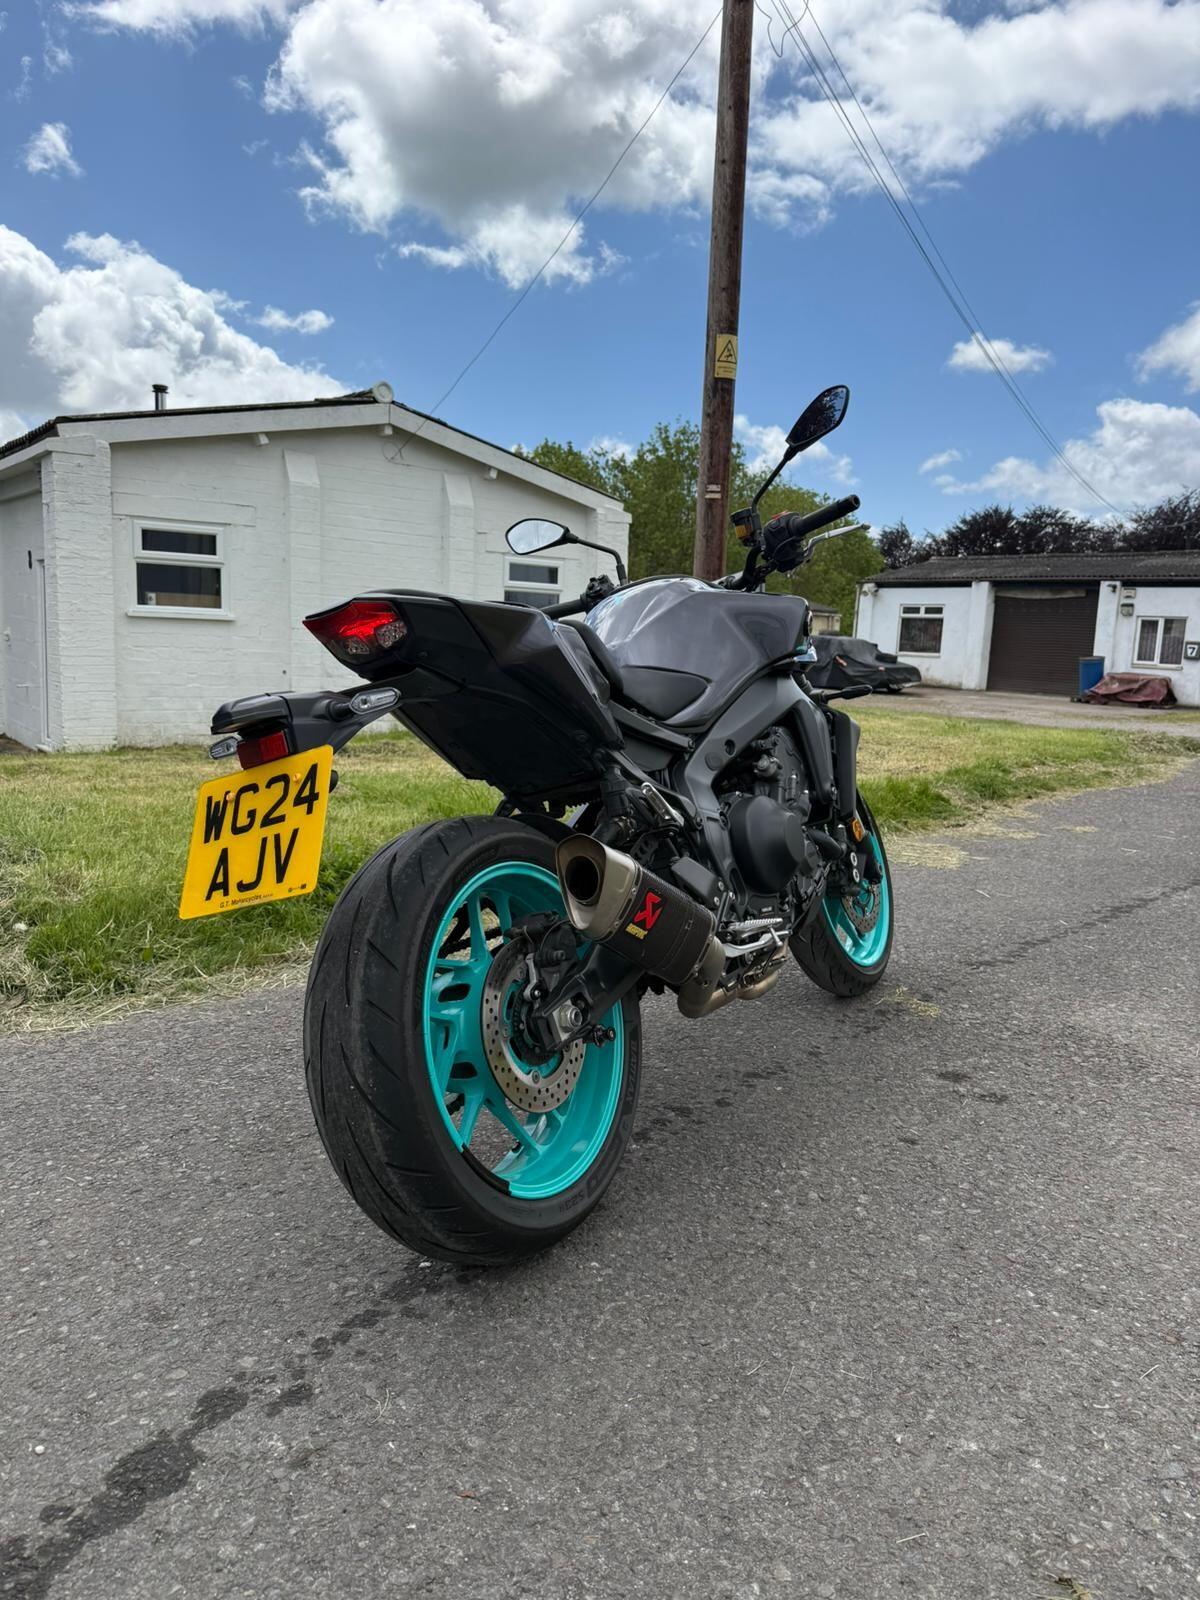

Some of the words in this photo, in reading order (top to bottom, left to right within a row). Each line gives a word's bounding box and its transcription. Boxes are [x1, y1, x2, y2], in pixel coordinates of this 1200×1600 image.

[1188, 646, 1196, 656] 7
[204, 763, 319, 844] WG24
[205, 828, 300, 901] AJV
[231, 895, 262, 906] Motorcycles
